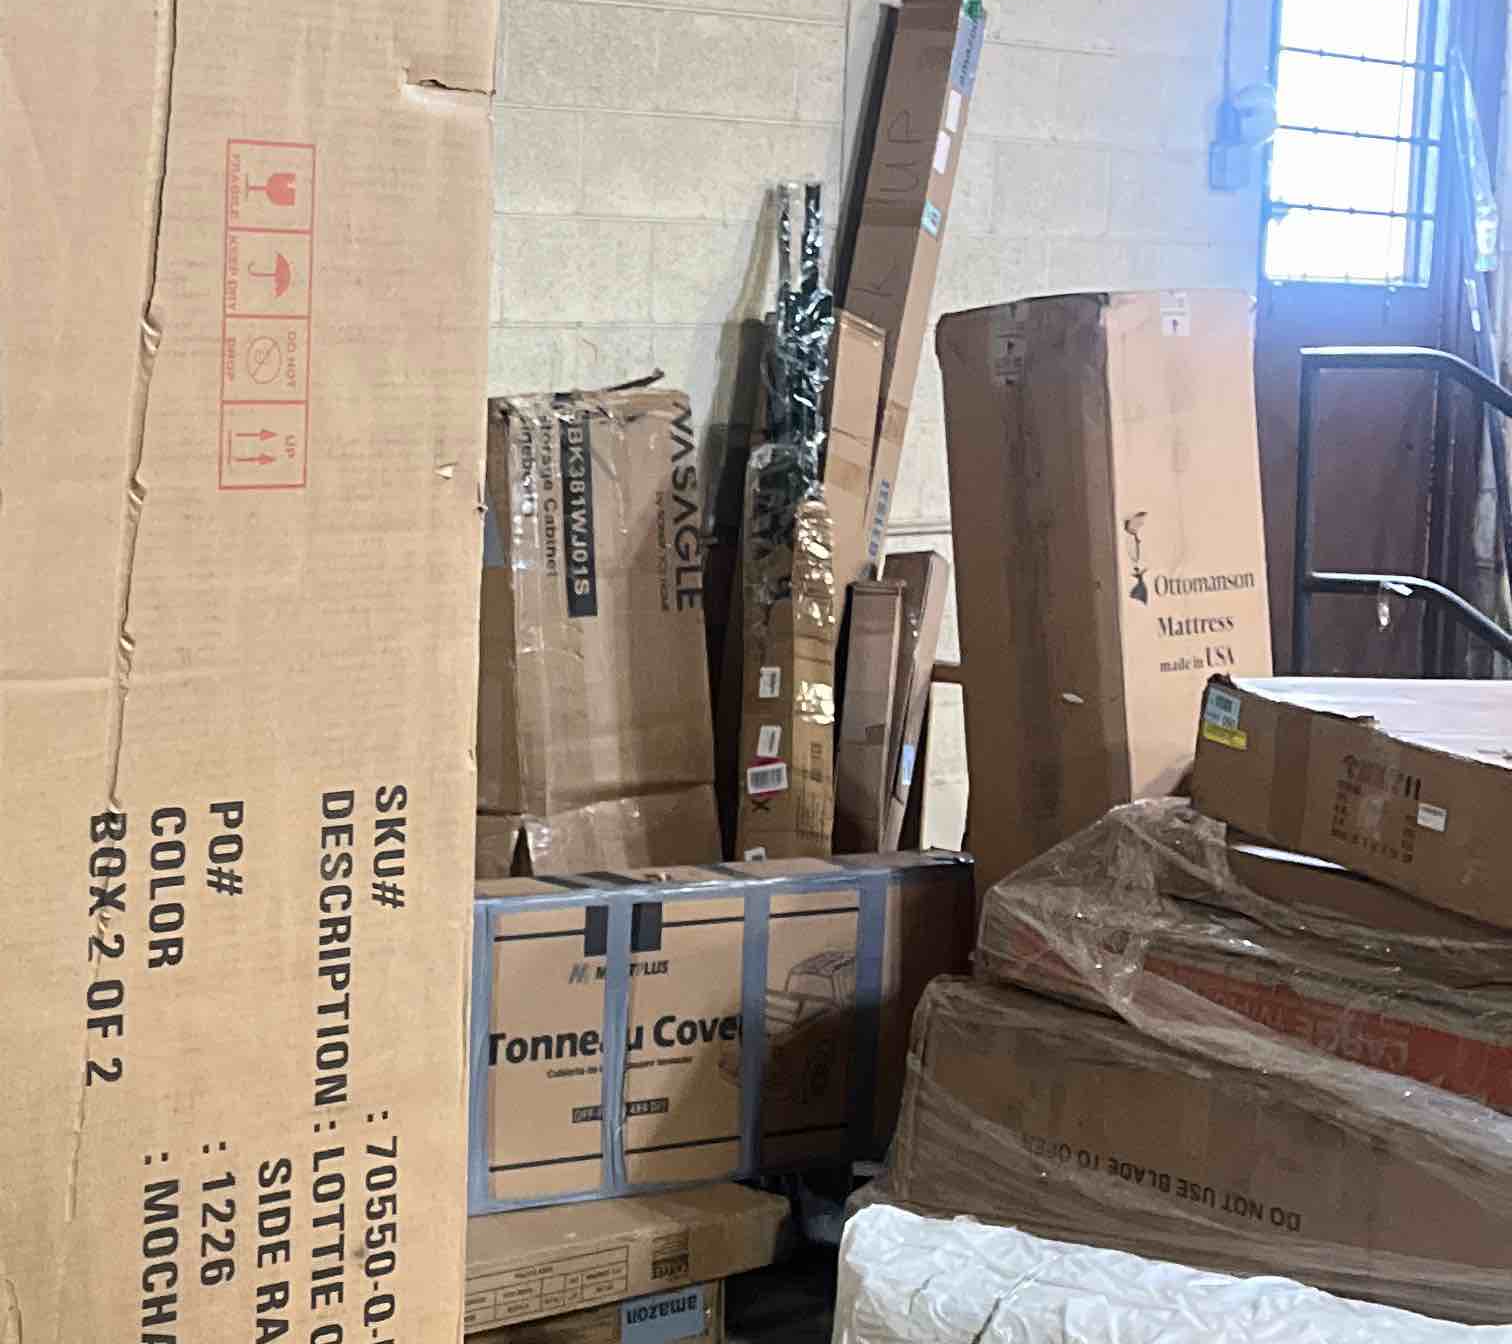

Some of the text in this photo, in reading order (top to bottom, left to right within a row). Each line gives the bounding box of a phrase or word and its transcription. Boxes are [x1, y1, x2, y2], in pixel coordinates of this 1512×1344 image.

[543, 498, 559, 577] Cabinet
[1154, 572, 1255, 595] Ottomanson
[1158, 616, 1234, 637] Mattress
[1160, 657, 1192, 672] made
[1206, 646, 1235, 667] USA
[206, 800, 244, 897] PO#
[371, 784, 407, 909] SKU#
[147, 806, 187, 969] COLOR
[85, 810, 127, 1087] BOX 2 OF 2
[313, 789, 355, 1106] DESCRIPTION
[487, 1012, 746, 1067] Tonneu Cove
[1078, 1150, 1099, 1169] TO
[1109, 1159, 1170, 1193] BLADE
[256, 1158, 292, 1266] SIDE
[1176, 1179, 1216, 1206] USE
[1222, 1193, 1264, 1220] NOT
[1269, 1207, 1302, 1232] DO
[200, 1170, 236, 1286] 1226
[310, 1145, 345, 1311] LOTTIE
[626, 1293, 698, 1325] amazon
